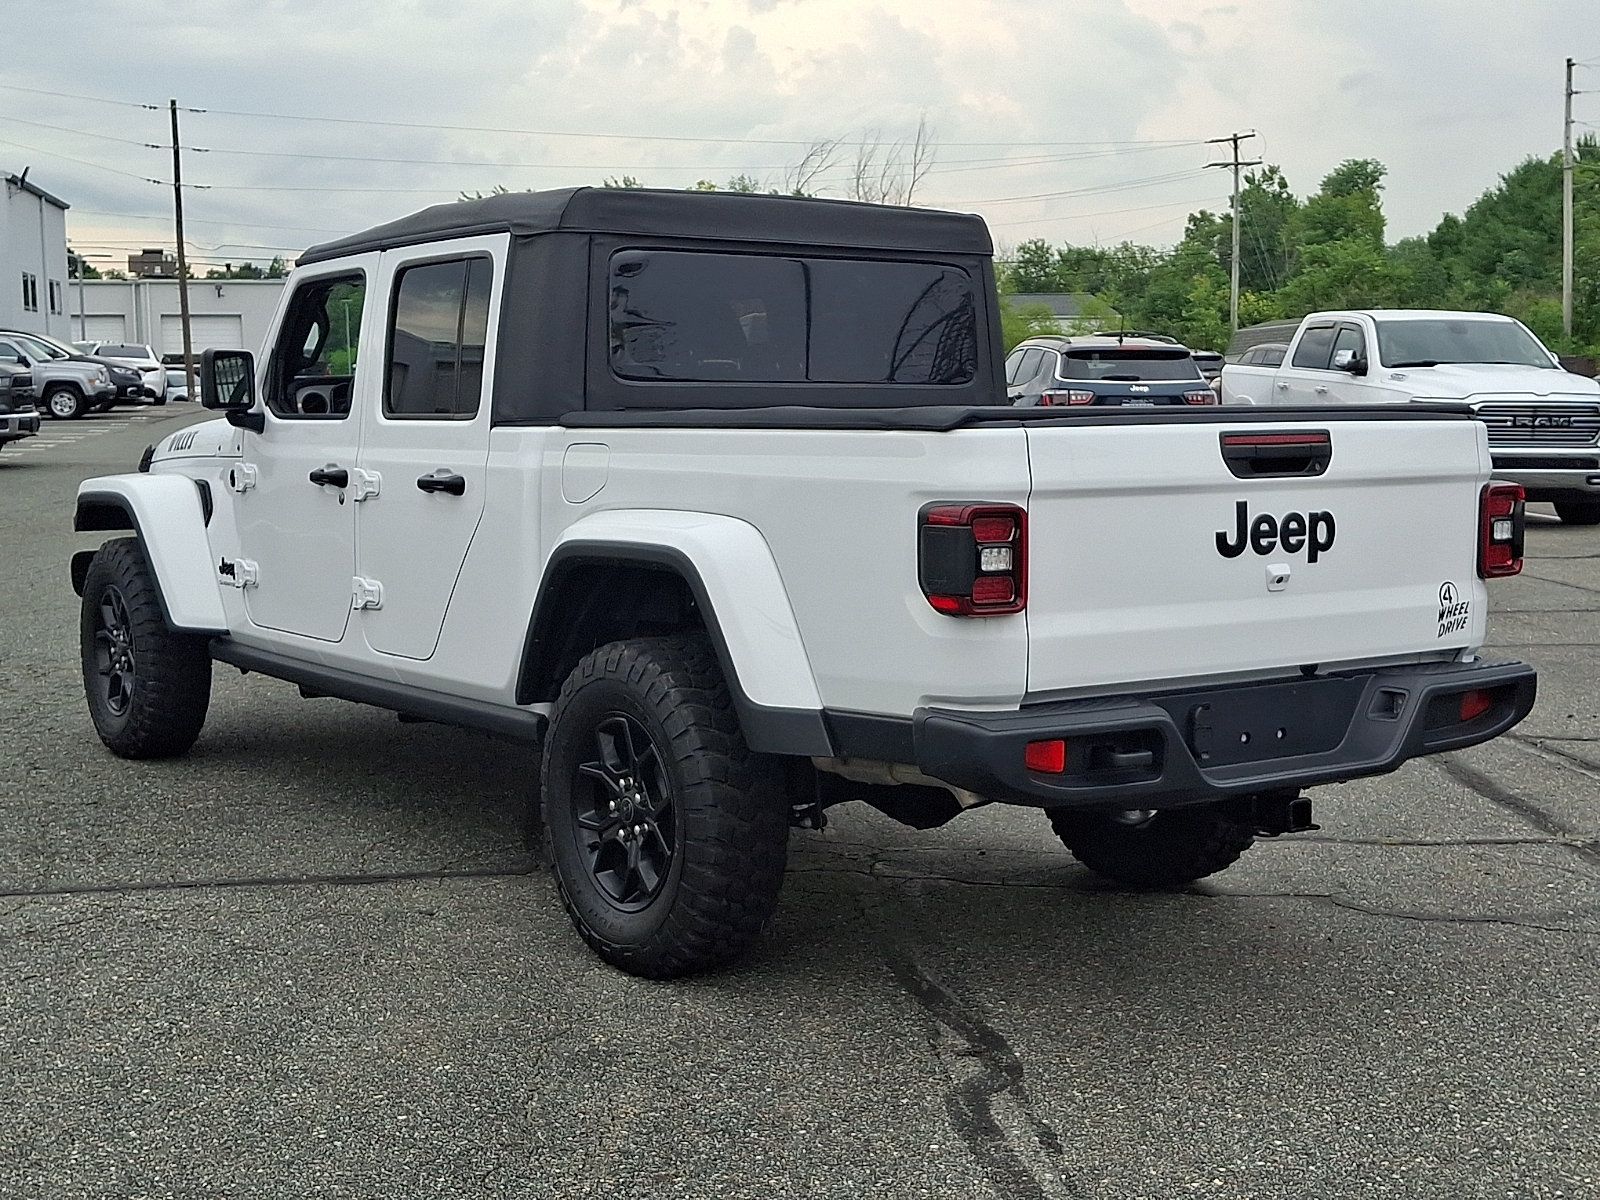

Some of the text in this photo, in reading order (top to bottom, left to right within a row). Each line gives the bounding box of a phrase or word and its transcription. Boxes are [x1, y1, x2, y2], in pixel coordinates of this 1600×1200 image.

[1129, 384, 1150, 393] Jeep
[1515, 416, 1570, 427] RAM
[1215, 500, 1336, 564] Jeep
[1438, 600, 1470, 623] WHEEL
[1438, 616, 1468, 638] DRIVE
